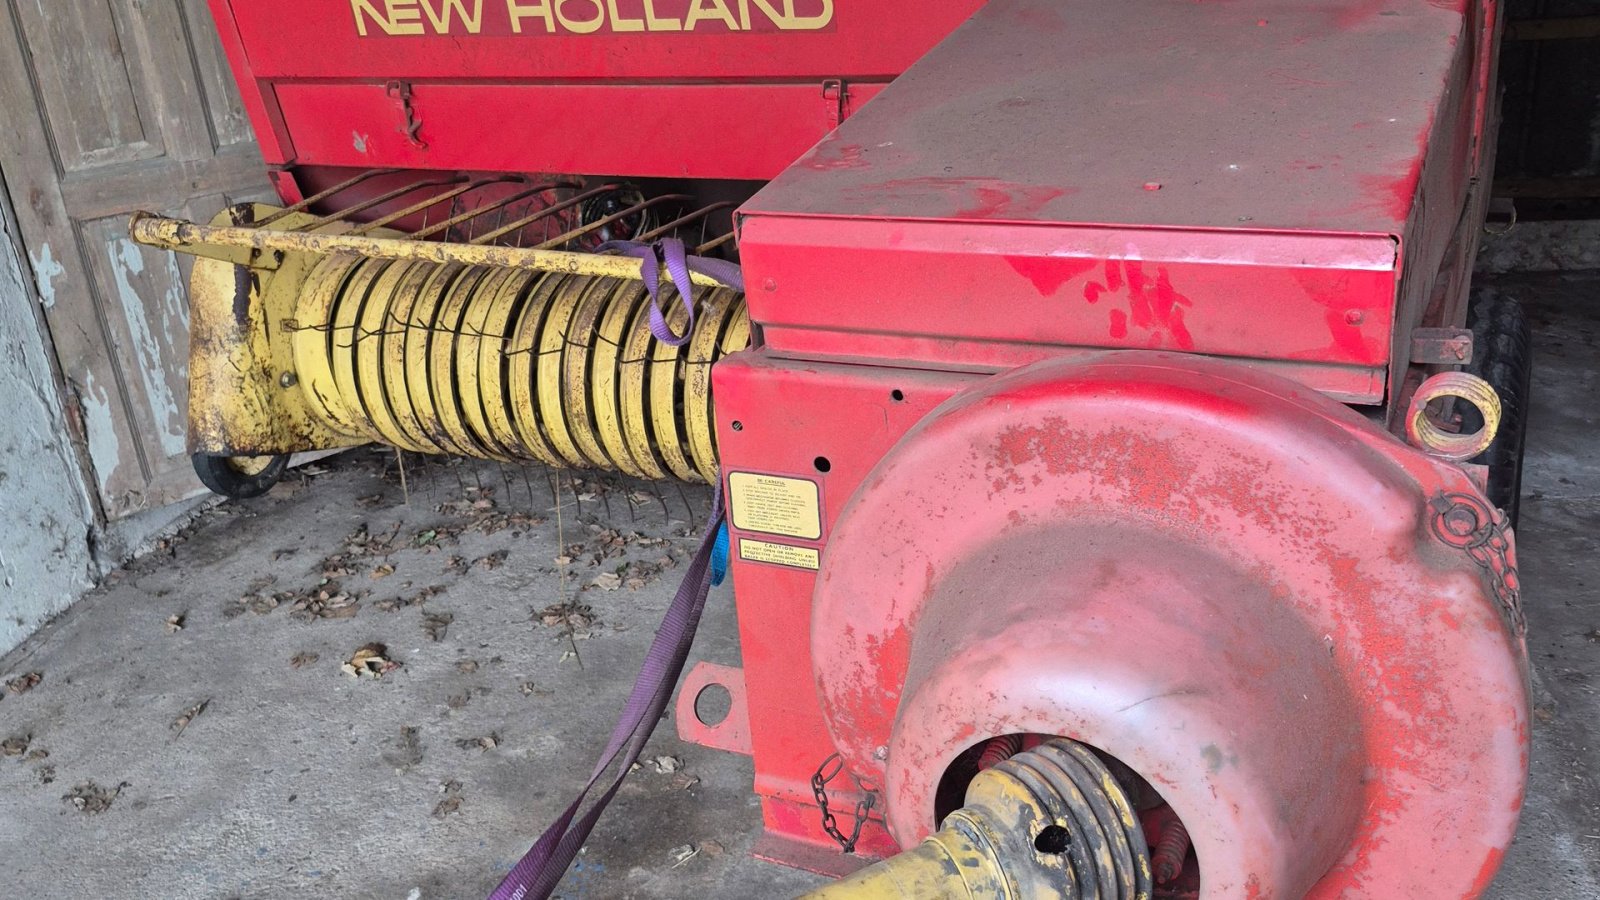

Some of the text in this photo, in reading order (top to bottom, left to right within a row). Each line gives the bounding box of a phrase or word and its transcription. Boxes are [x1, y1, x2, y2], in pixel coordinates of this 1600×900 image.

[351, 0, 834, 36] NEW HOLLAND
[764, 543, 794, 551] CAUTION
